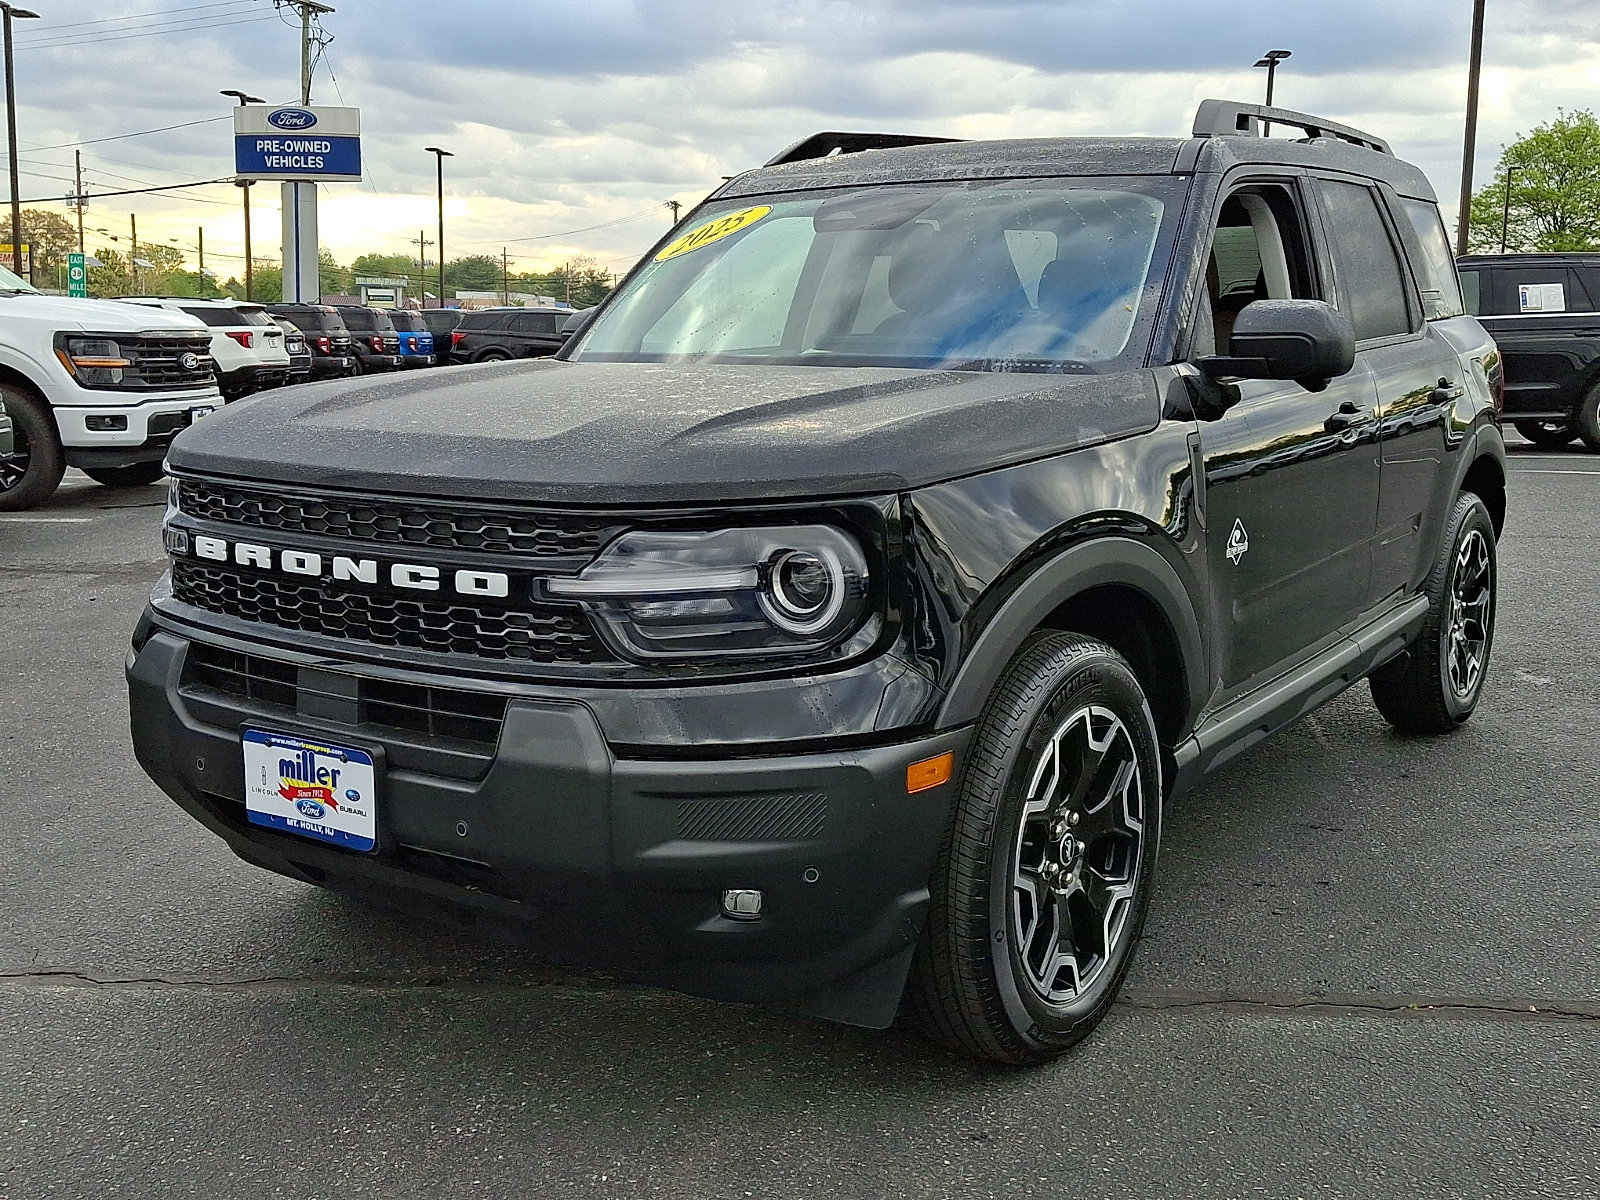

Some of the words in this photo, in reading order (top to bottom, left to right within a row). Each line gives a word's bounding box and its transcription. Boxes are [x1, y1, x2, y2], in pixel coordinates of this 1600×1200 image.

[277, 112, 306, 126] Ford
[256, 140, 331, 153] PRE-OWNED
[264, 155, 324, 168] VEHICLES
[667, 209, 754, 256] 2025
[70, 255, 83, 264] EAST
[72, 269, 82, 277] 38
[69, 283, 84, 291] MILE
[195, 535, 508, 597] BRONCO
[279, 750, 340, 787] miller
[251, 786, 279, 797] LINCOLN
[297, 790, 312, 798] Since
[312, 790, 324, 798] 1912
[301, 800, 320, 816] Ford
[339, 805, 368, 818] SUBARU
[286, 817, 299, 828] MT.
[300, 820, 324, 835] HOLLY,
[324, 827, 335, 837] NJ
